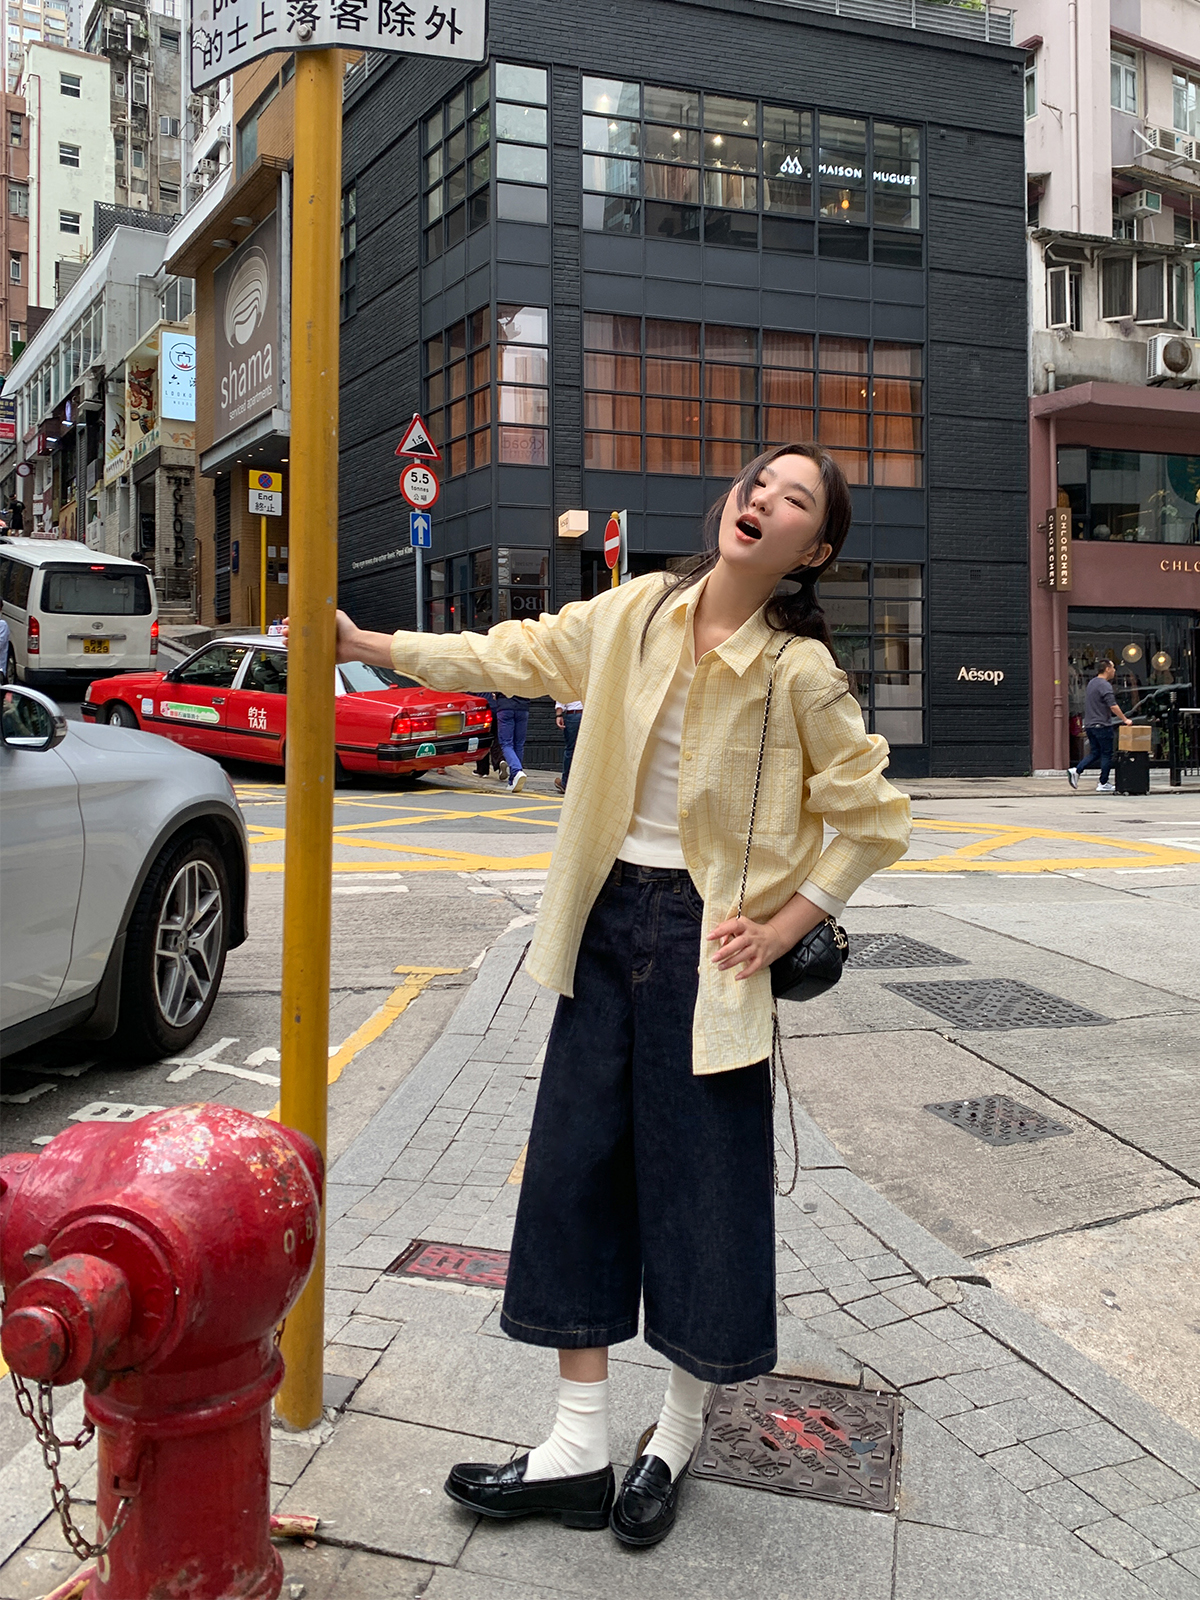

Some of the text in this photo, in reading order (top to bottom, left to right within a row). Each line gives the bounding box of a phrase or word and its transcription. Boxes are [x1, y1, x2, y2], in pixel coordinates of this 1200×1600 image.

[818, 164, 917, 185] MAISON MUGUET
[221, 343, 272, 408] shama
[229, 384, 272, 420] serviced apartments
[411, 435, 424, 445] 1:5
[166, 476, 191, 486] THE
[411, 472, 429, 484] 5.5
[411, 485, 429, 493] tonnes
[258, 493, 273, 501] End
[173, 488, 185, 567] GLOBE
[248, 706, 267, 719] 的士
[248, 717, 267, 729] TAXI
